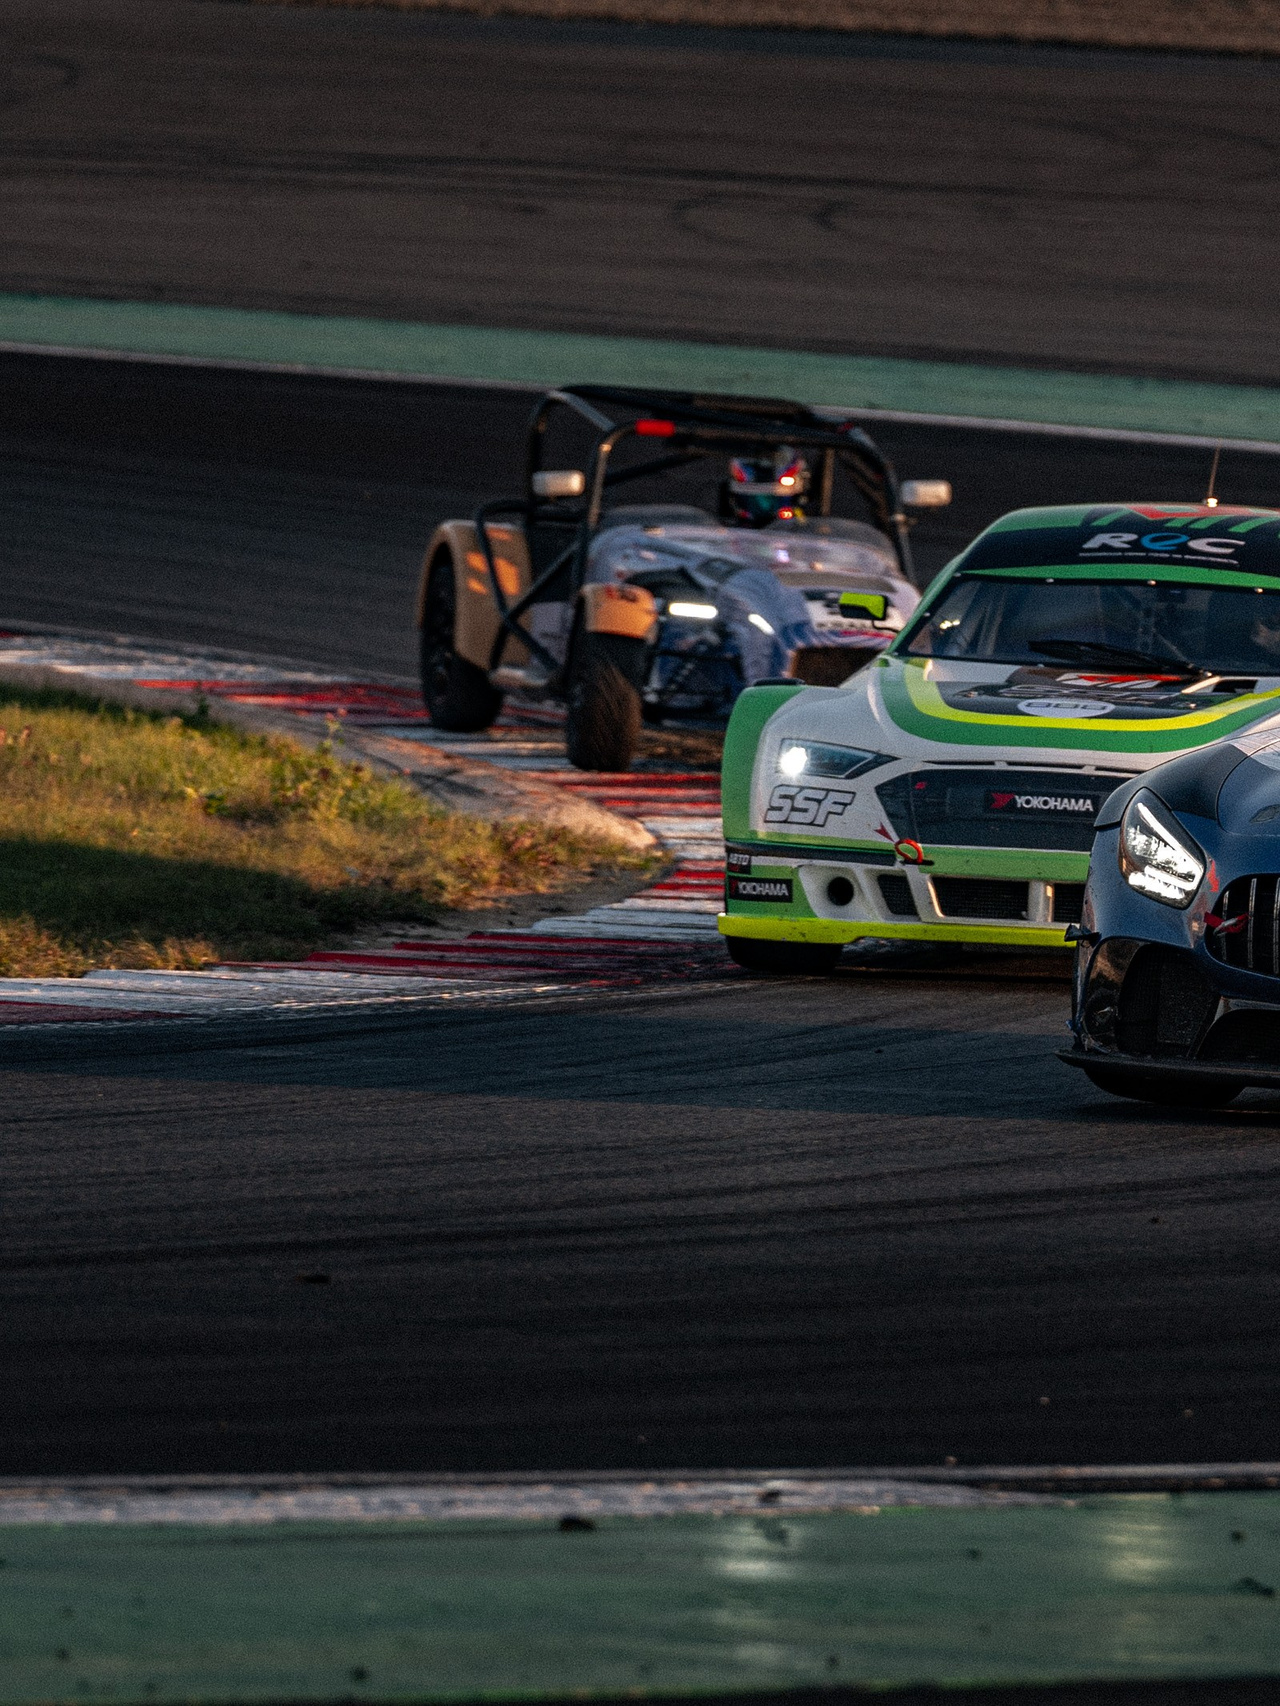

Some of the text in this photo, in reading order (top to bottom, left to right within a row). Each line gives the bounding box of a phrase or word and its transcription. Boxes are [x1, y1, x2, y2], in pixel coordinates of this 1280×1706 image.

[764, 784, 857, 828] SSF
[1015, 795, 1094, 812] YOKOHAMA
[738, 882, 789, 897] YOKOHAMA
